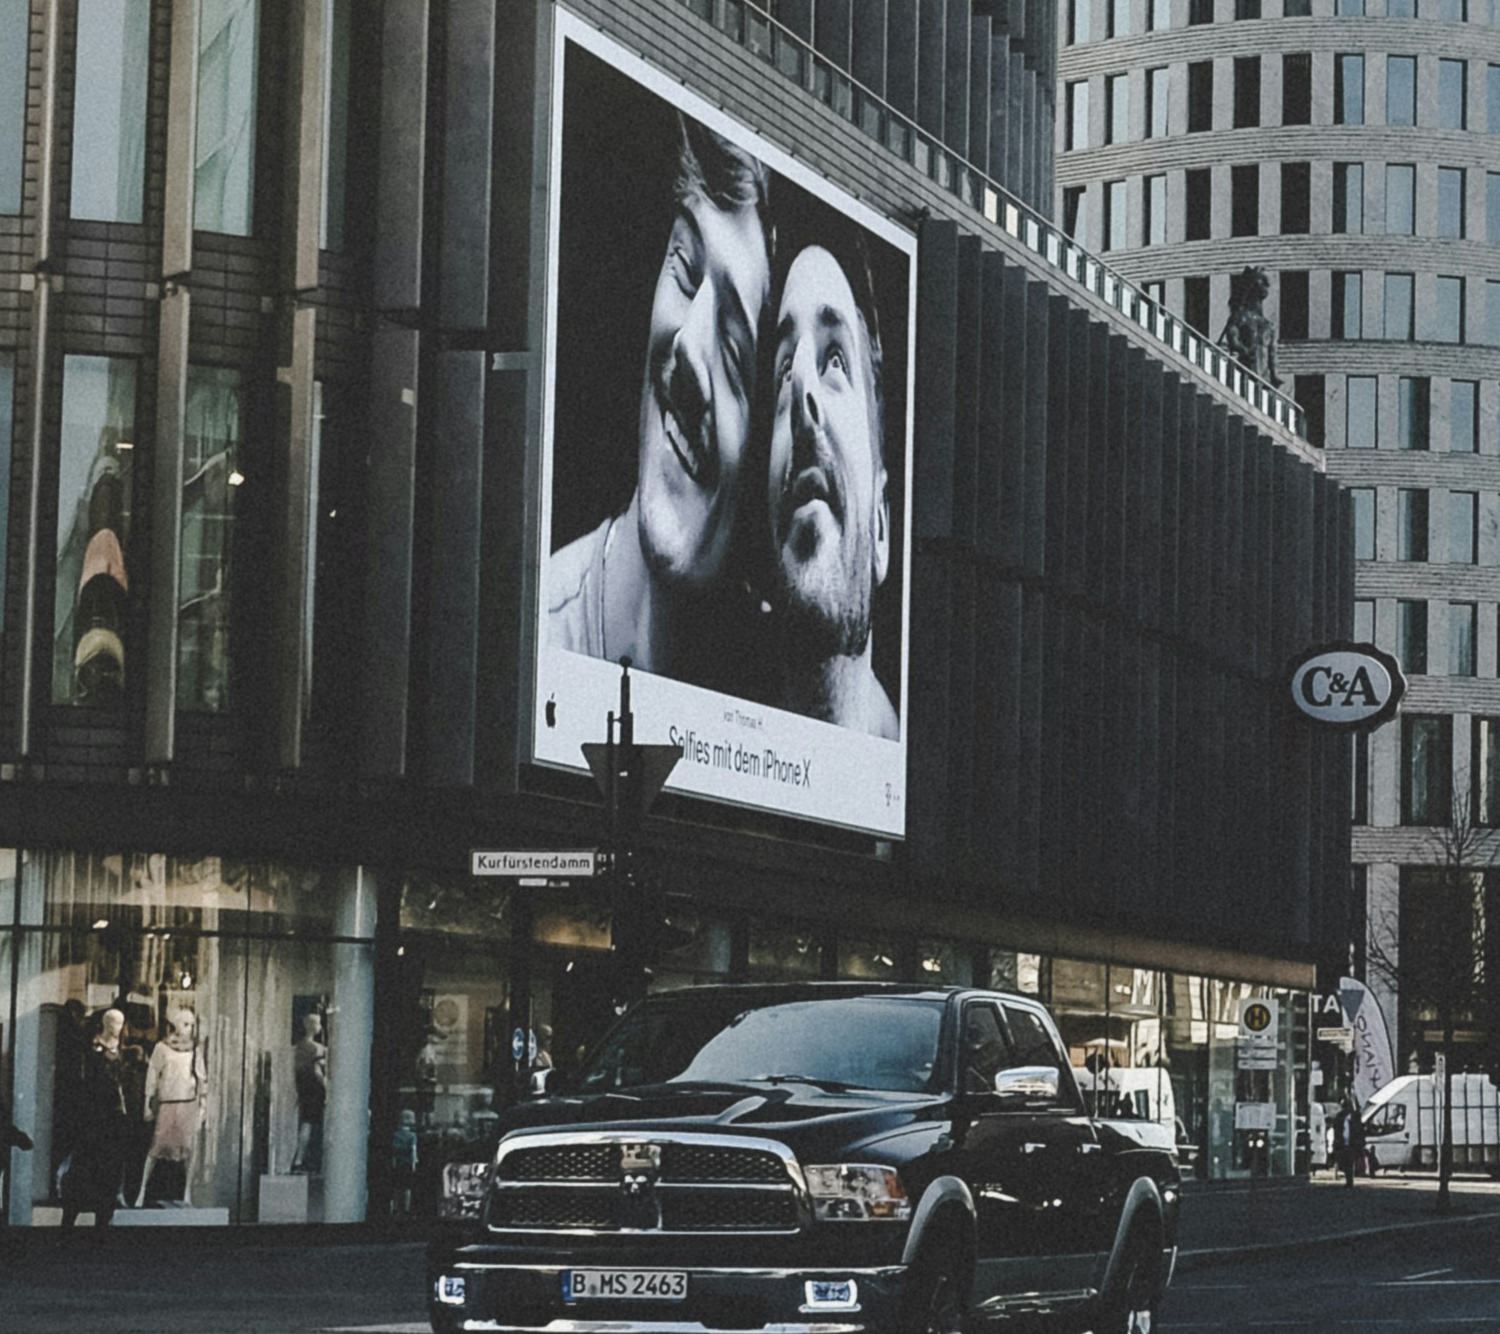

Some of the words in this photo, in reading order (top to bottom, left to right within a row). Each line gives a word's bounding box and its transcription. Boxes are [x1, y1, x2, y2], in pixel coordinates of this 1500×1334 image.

[1301, 665, 1382, 707] C&A
[713, 739, 732, 770] mit
[734, 743, 760, 776] dem
[477, 855, 590, 869] Kurfürstendamm
[632, 1274, 685, 1296] 2463
